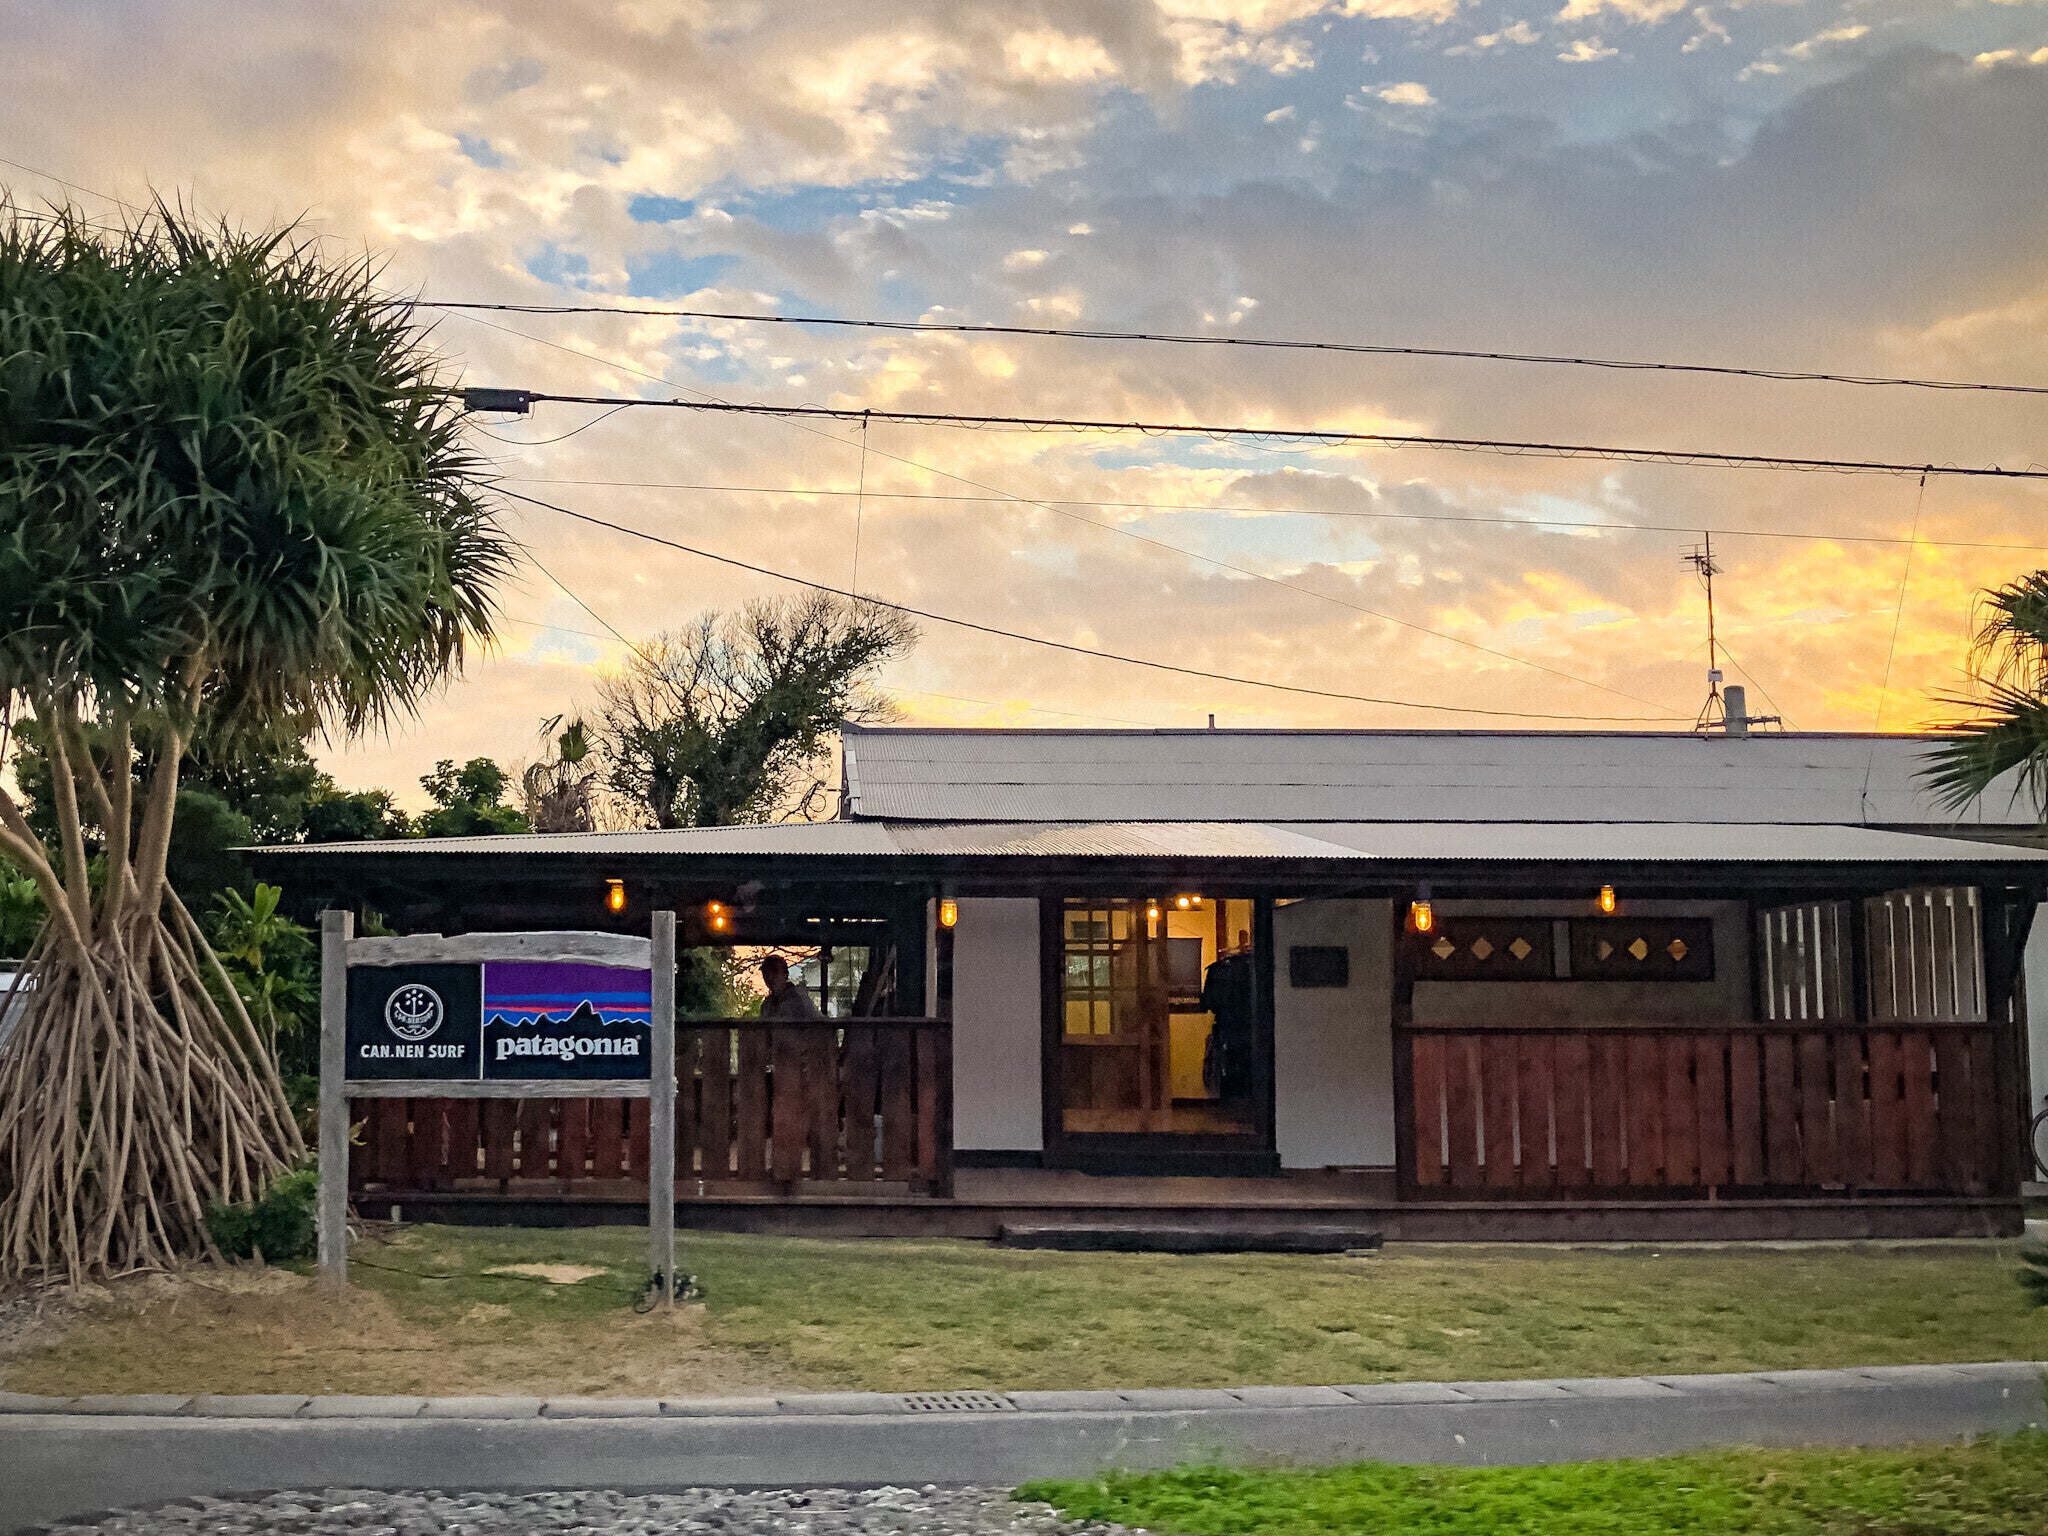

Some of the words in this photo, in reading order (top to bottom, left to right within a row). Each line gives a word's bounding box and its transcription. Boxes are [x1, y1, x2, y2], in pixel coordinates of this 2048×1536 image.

[360, 1044, 425, 1058] CAN.NEN
[429, 1044, 465, 1058] SURF
[495, 1034, 640, 1061] patagonia
